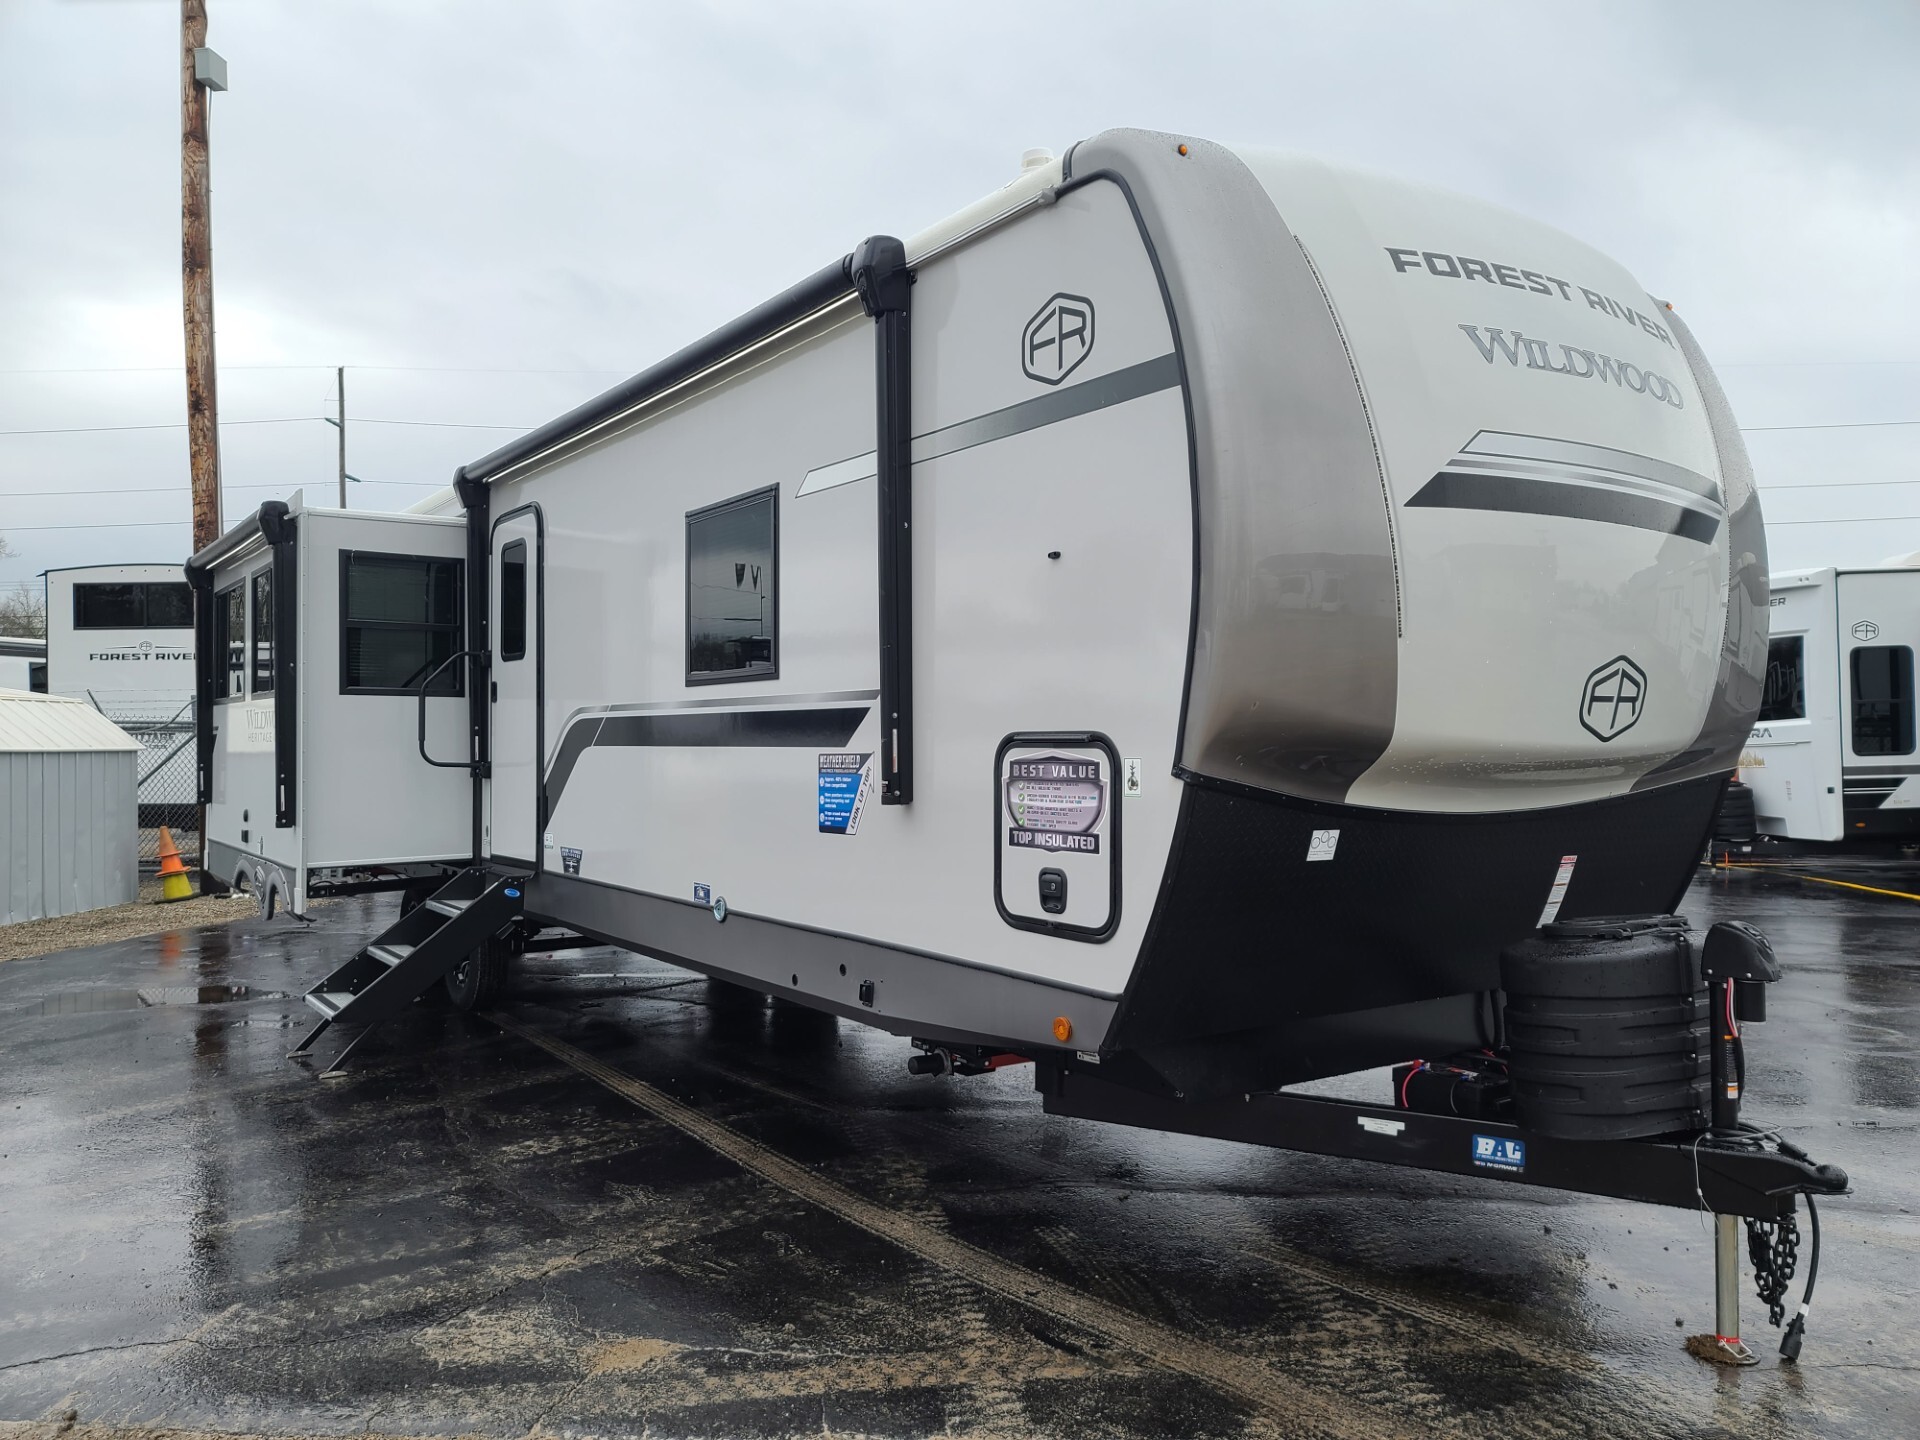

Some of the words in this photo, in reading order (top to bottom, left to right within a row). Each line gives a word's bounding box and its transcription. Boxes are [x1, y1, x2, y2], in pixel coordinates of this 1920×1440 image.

[1383, 246, 1572, 301] FOREST
[1577, 284, 1677, 350] RIVER
[1457, 322, 1685, 411] WILDWOOD
[89, 653, 151, 661] FOREST
[1748, 728, 1772, 739] RA
[1012, 764, 1045, 778] BEST
[1051, 764, 1096, 779] VALUE
[850, 806, 861, 830] LOOK
[1012, 830, 1032, 846] TOP
[1034, 833, 1095, 850] INSULATED
